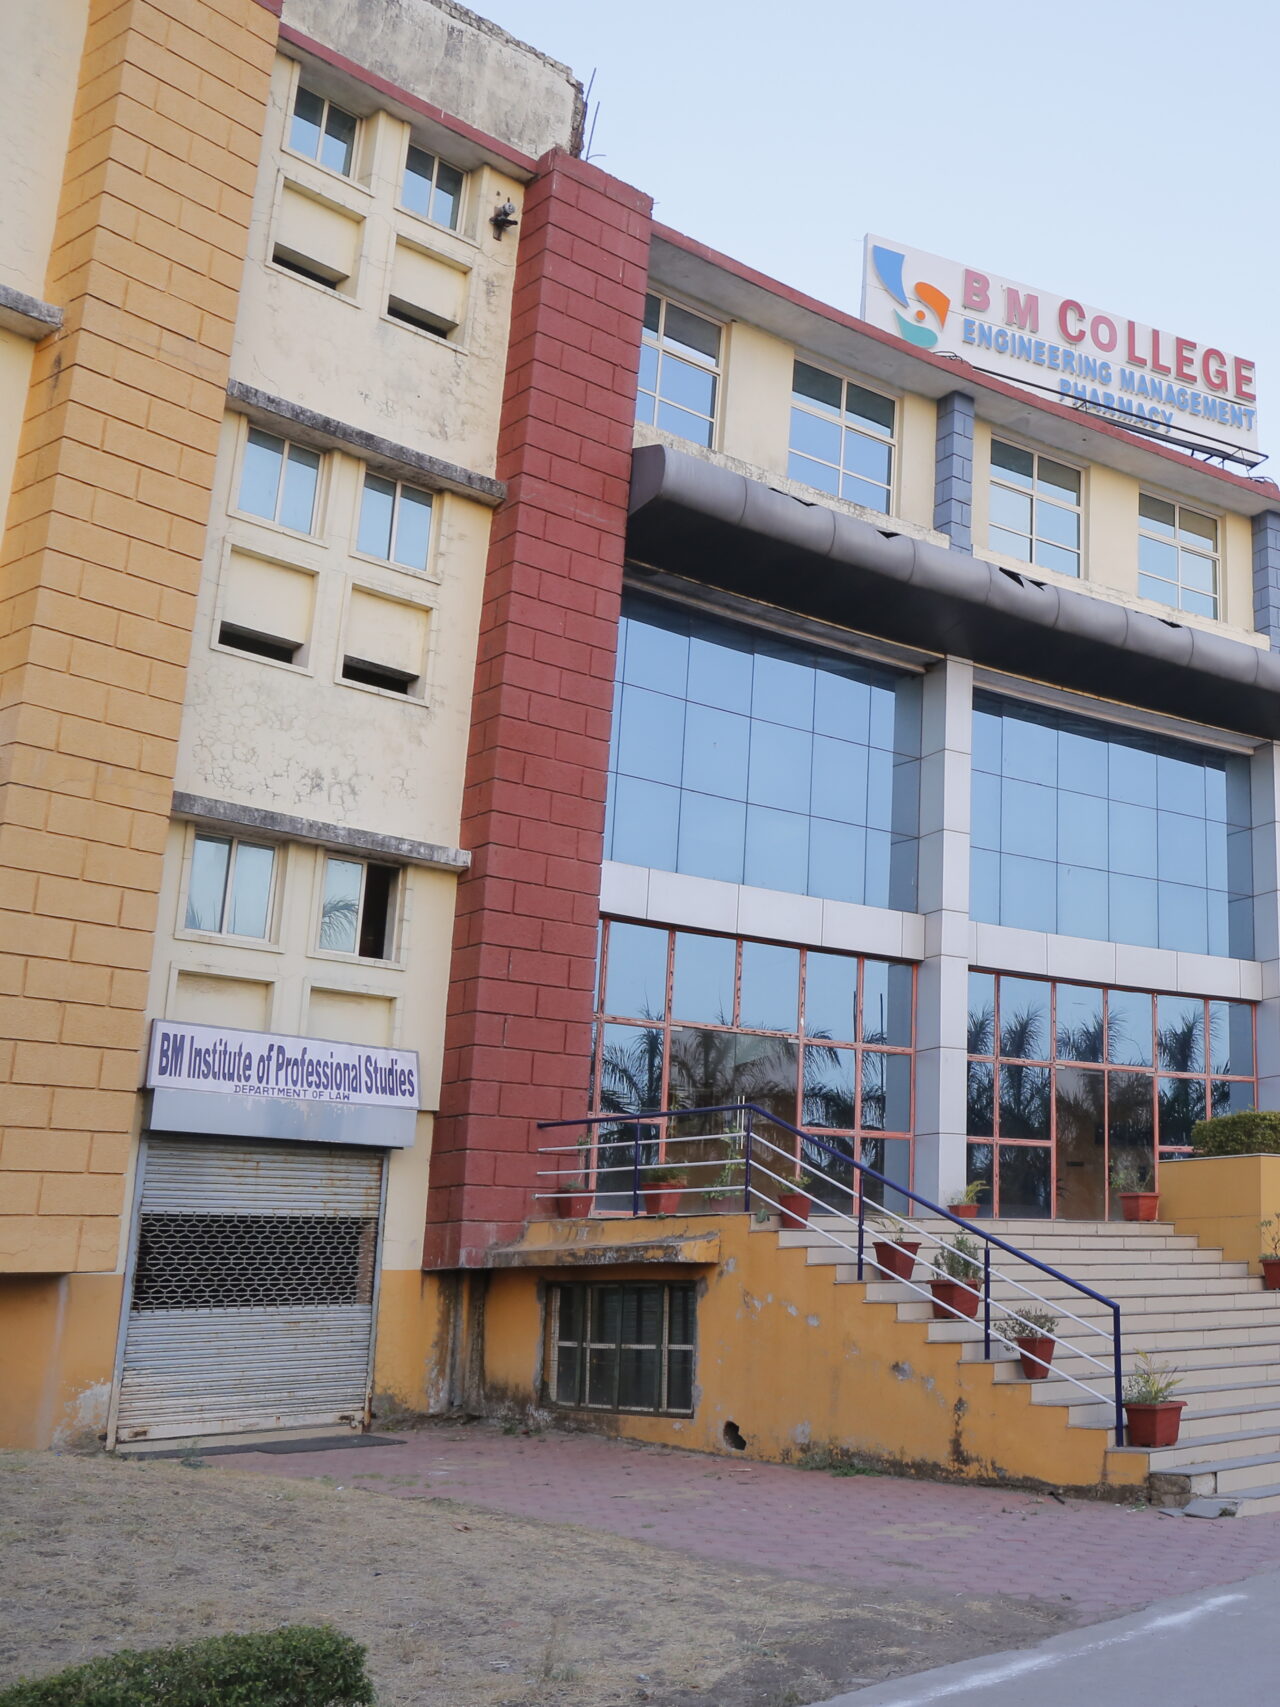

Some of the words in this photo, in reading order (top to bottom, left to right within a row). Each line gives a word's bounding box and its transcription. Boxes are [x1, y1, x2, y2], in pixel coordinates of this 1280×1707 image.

[963, 268, 991, 311] B
[1005, 285, 1040, 333] M
[1058, 298, 1257, 401] COLLEGE
[962, 318, 1113, 385] ENGINEERING
[1119, 367, 1256, 431] MANAGEMENT
[1058, 378, 1174, 434] PHARMACY
[157, 1032, 185, 1077] BM
[187, 1035, 252, 1083] Institute
[256, 1043, 274, 1085] of
[275, 1045, 362, 1093] Professional
[364, 1054, 415, 1098] Studies
[233, 1084, 309, 1099] DEPARTMENT
[311, 1090, 325, 1100] OF
[328, 1091, 350, 1101] LAW
